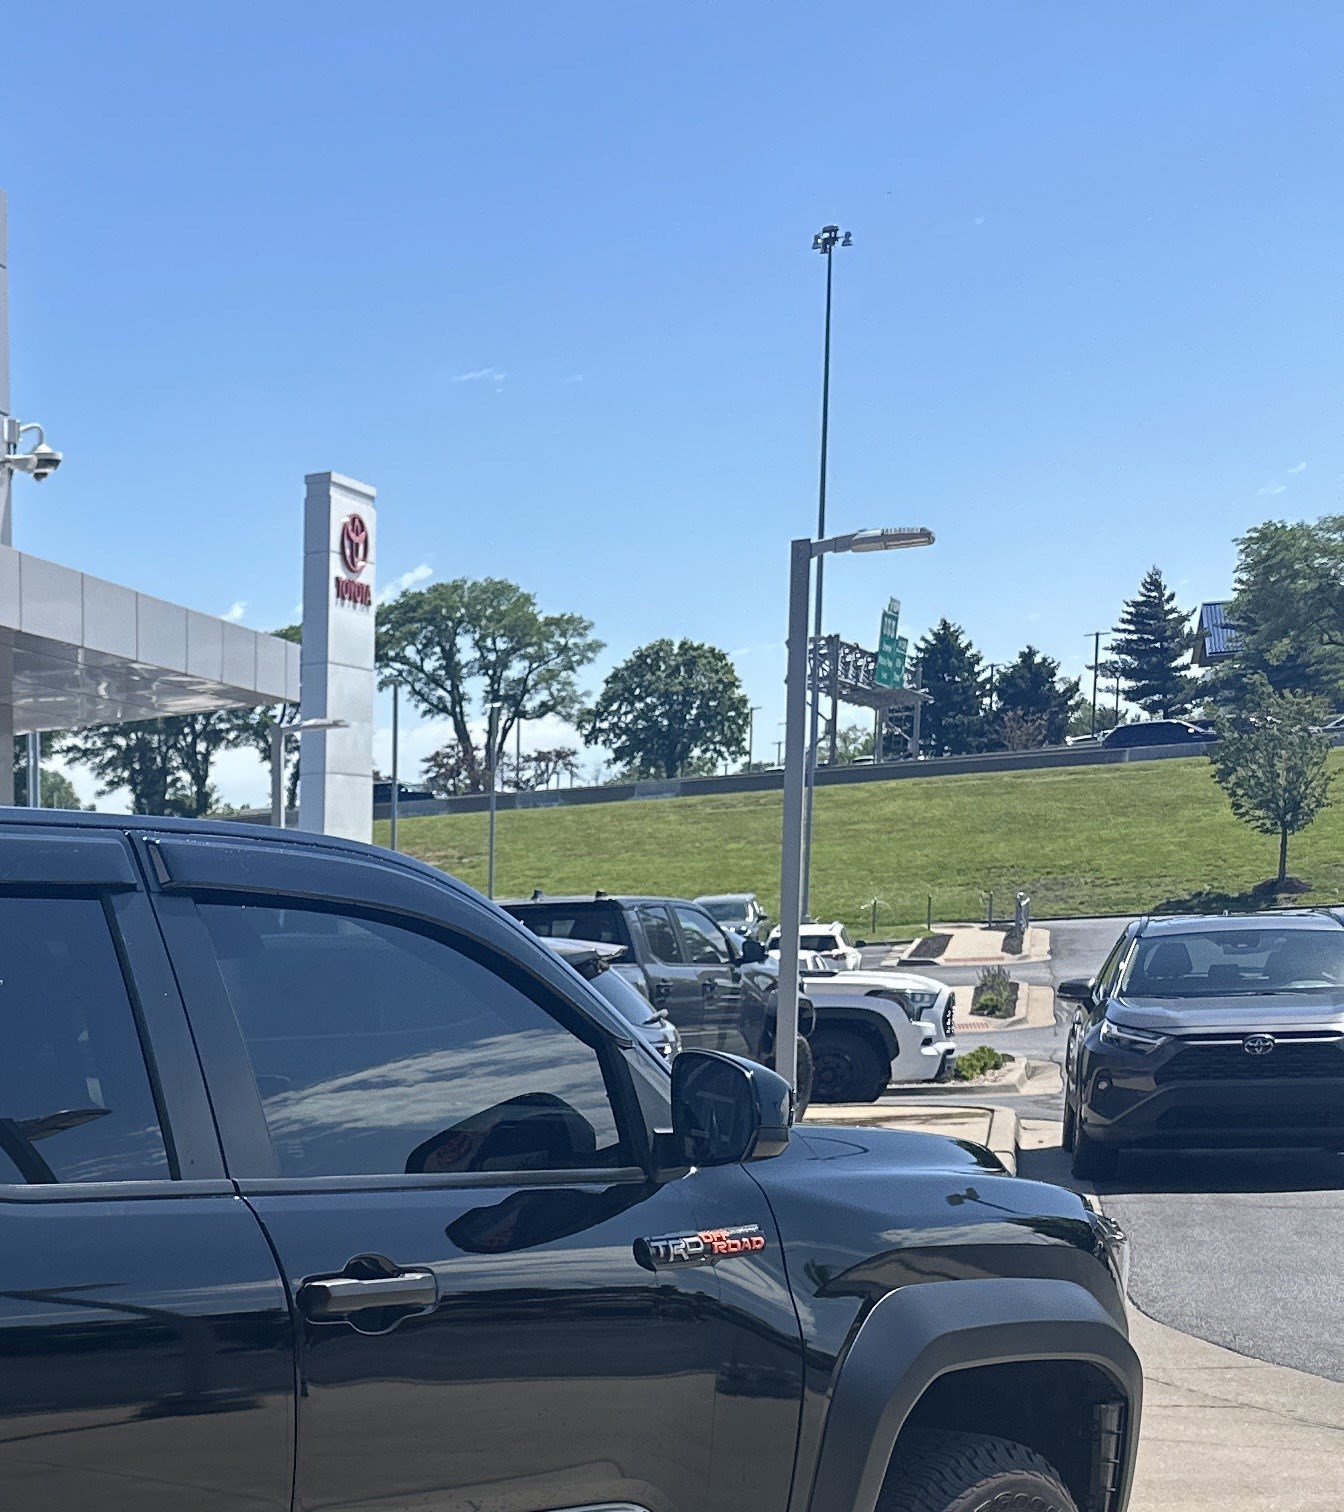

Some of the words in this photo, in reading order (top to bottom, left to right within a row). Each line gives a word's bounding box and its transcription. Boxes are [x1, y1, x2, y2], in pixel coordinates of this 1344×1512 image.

[335, 576, 372, 608] TOYOTA
[649, 1235, 705, 1263] TRD
[711, 1235, 766, 1255] ROAD
[697, 1229, 732, 1243] OFF
